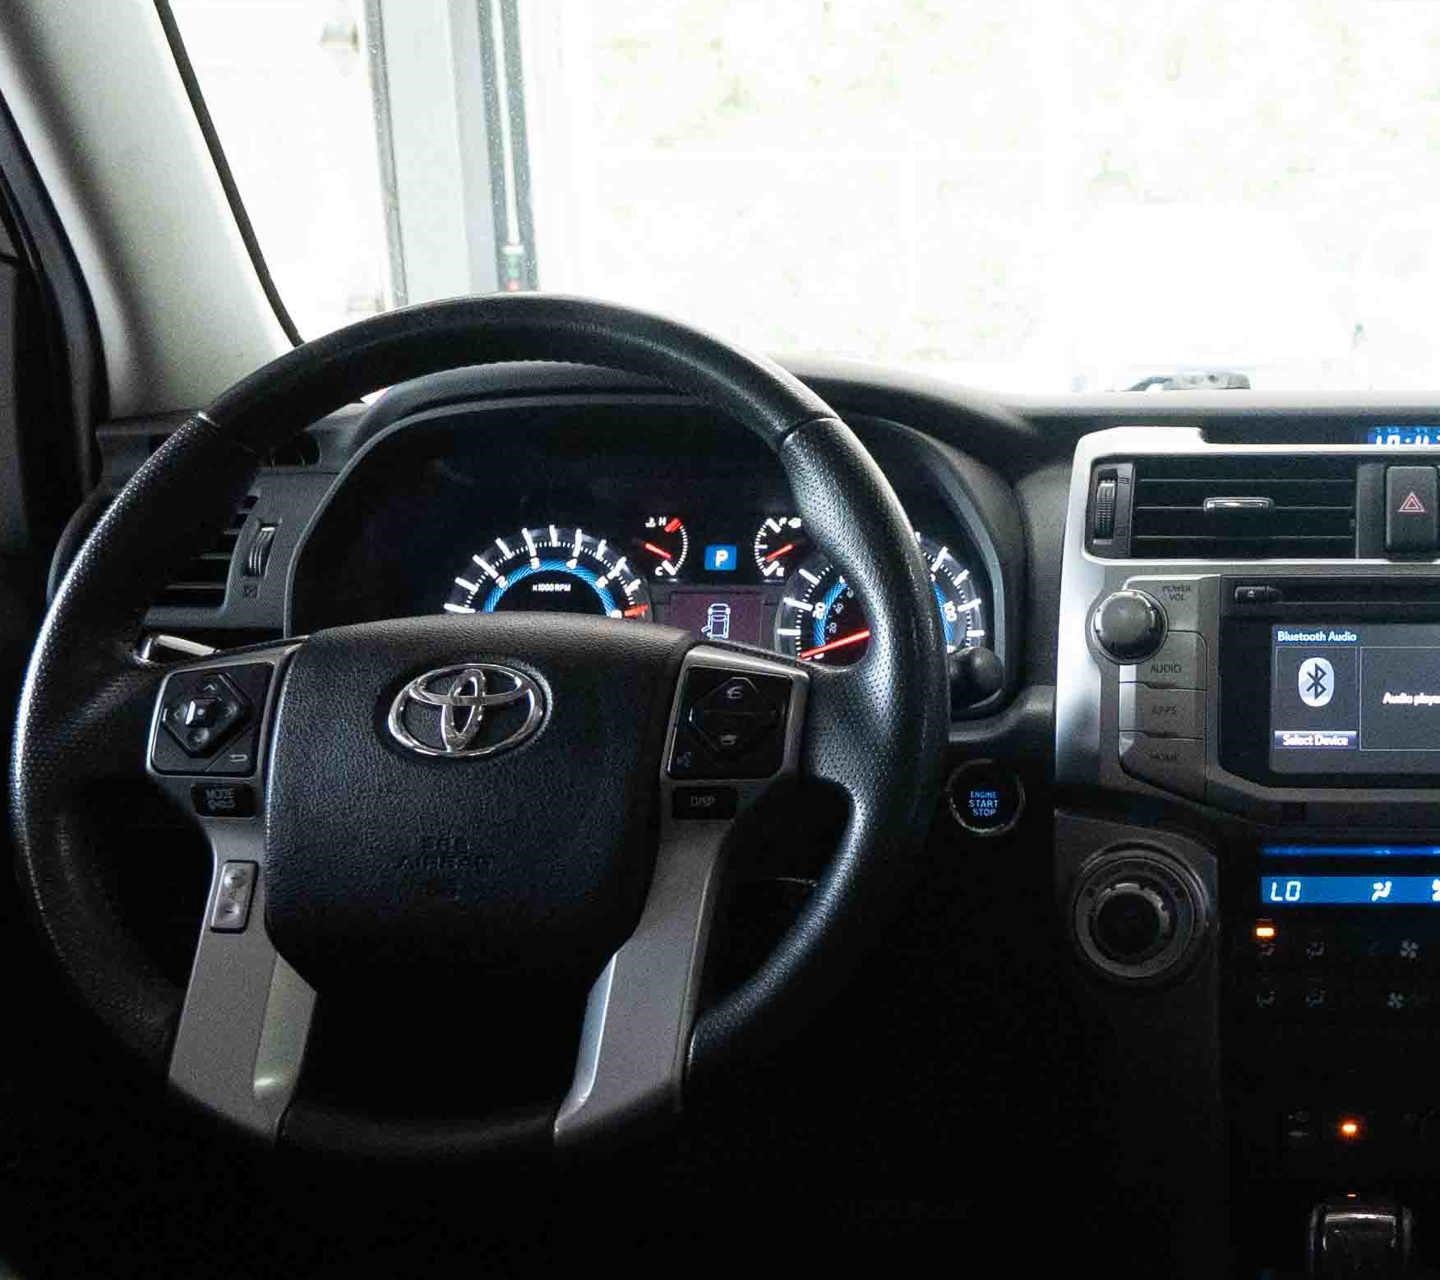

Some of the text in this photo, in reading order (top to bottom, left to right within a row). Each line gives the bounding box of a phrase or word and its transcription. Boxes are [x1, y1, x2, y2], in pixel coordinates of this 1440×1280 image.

[658, 516, 667, 526] H
[715, 549, 728, 568] P
[654, 566, 664, 576] C
[555, 583, 572, 592] RPM
[1169, 593, 1185, 602] VOL
[1277, 630, 1357, 642] Bluetooth Audio
[1150, 663, 1183, 674] AUDIO
[1382, 692, 1413, 704] Audio
[1283, 734, 1349, 746] Select Device
[970, 791, 997, 799] ENGINE
[968, 799, 999, 808] START
[972, 808, 997, 817] STOP
[1270, 880, 1302, 902] LO
